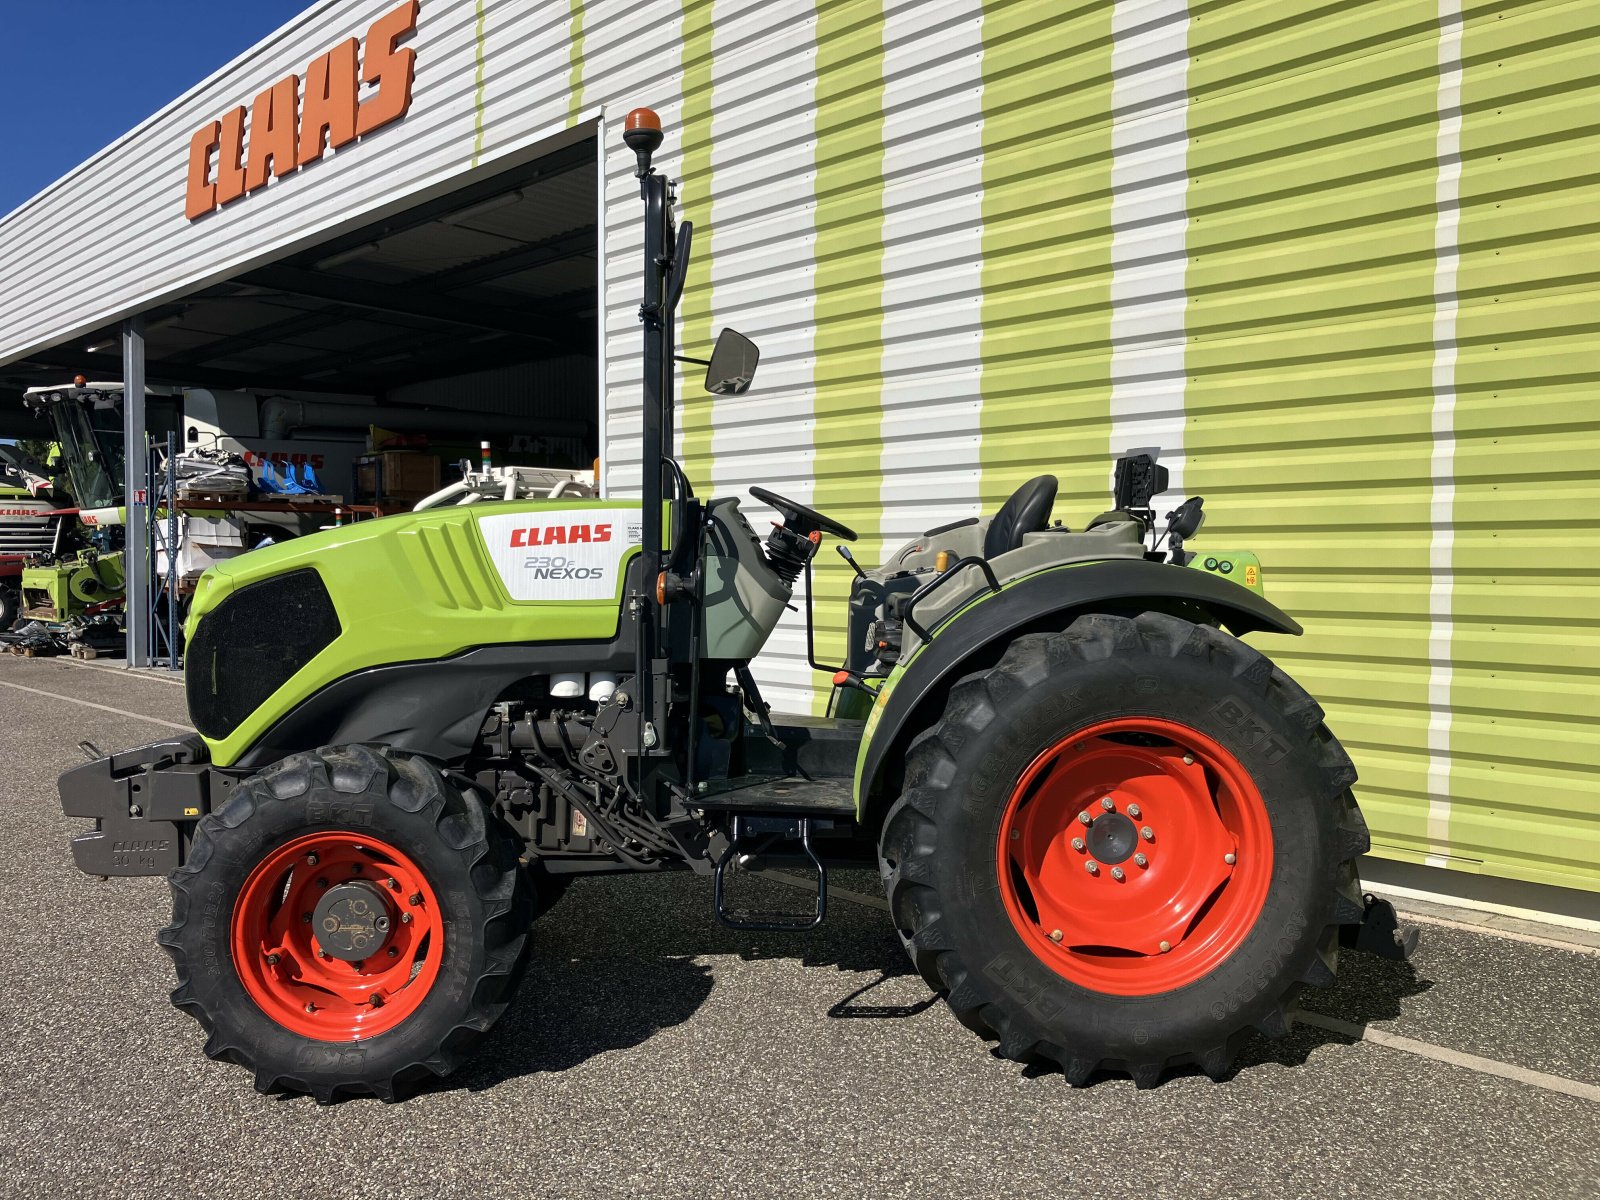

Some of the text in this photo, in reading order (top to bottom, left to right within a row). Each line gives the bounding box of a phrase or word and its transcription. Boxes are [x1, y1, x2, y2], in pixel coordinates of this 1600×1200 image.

[184, 0, 417, 220] CLAAS
[243, 451, 325, 469] CLAAS
[510, 523, 612, 548] CLAAS
[533, 567, 604, 580] NEXOS
[1209, 697, 1293, 764] BKT
[307, 803, 373, 827] BKT
[112, 840, 170, 853] CLAAS
[139, 856, 155, 869] kg
[984, 954, 1068, 1021] BKT
